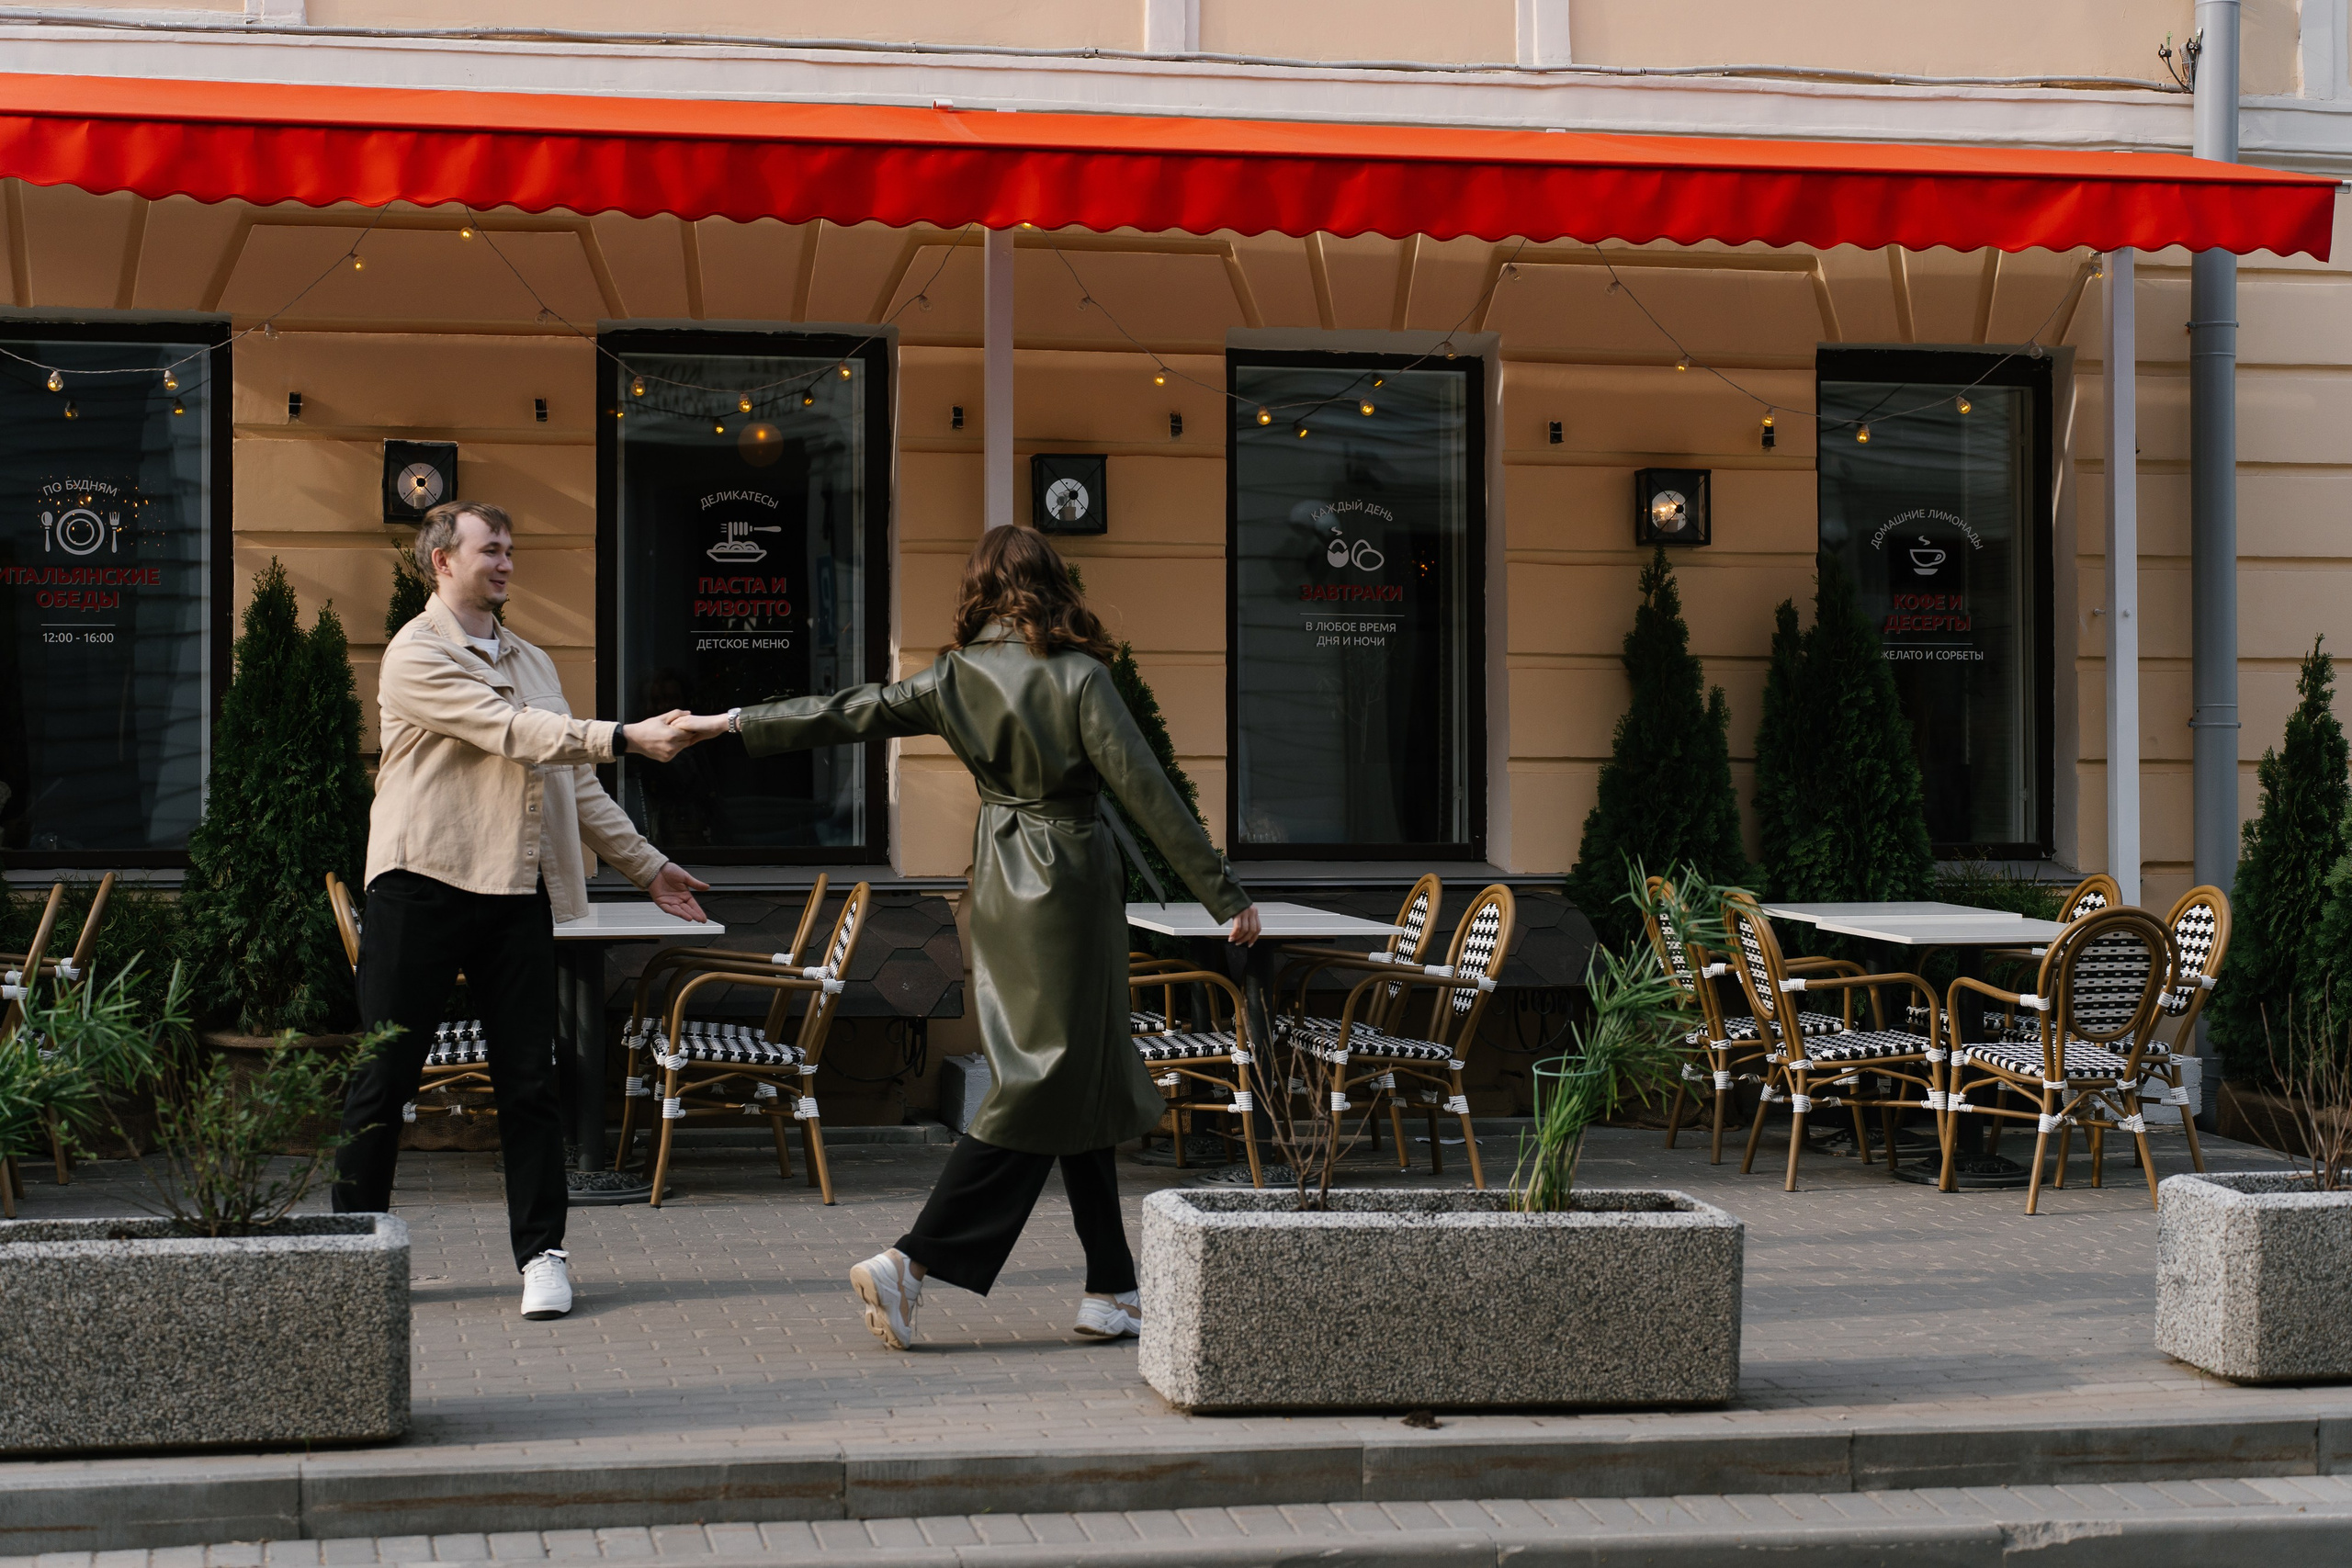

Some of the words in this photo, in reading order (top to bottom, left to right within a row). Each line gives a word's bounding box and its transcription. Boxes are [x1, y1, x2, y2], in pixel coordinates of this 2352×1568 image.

[43, 482, 62, 496] ПО
[65, 479, 119, 497] БУДНЯМ
[700, 491, 779, 510] ДЕЛИКАТЕСЫ
[1311, 499, 1363, 521] КАЖДЫЙ
[1364, 502, 1393, 522] ДЕНЬ
[1871, 509, 1925, 549] ДОМАШНИЕ
[1928, 509, 1984, 550] ЛИМОНАДЫ
[0, 566, 161, 585] ИТАЛЬЯНСКИЕ
[698, 577, 767, 593] ПАСТА
[771, 577, 787, 593] И
[1300, 584, 1403, 601] ЗАВТРАКИ
[36, 590, 119, 612] ОБЕДЫ
[694, 599, 792, 617] РИЗОТТО
[1894, 594, 1946, 611] КОФЕ
[1950, 594, 1963, 611] И
[1306, 622, 1313, 631] В
[1316, 622, 1356, 632] ЛЮБОЕ
[1360, 623, 1396, 633] ВРЕМЯ
[1883, 615, 1972, 634] ДЕСЕРТЫ
[42, 633, 73, 643] 12:00
[84, 633, 114, 643] 16:00
[696, 638, 749, 650] ДЕТСКОЕ
[752, 638, 790, 649] МЕНЮ
[1317, 636, 1340, 647] ДНЯ
[1343, 637, 1351, 646] И
[1353, 637, 1385, 646] НОЧИ
[1880, 650, 1923, 660] ЖЕЛАТО
[1926, 650, 1933, 660] И
[1936, 650, 1984, 660] СОРБЕТЫ
